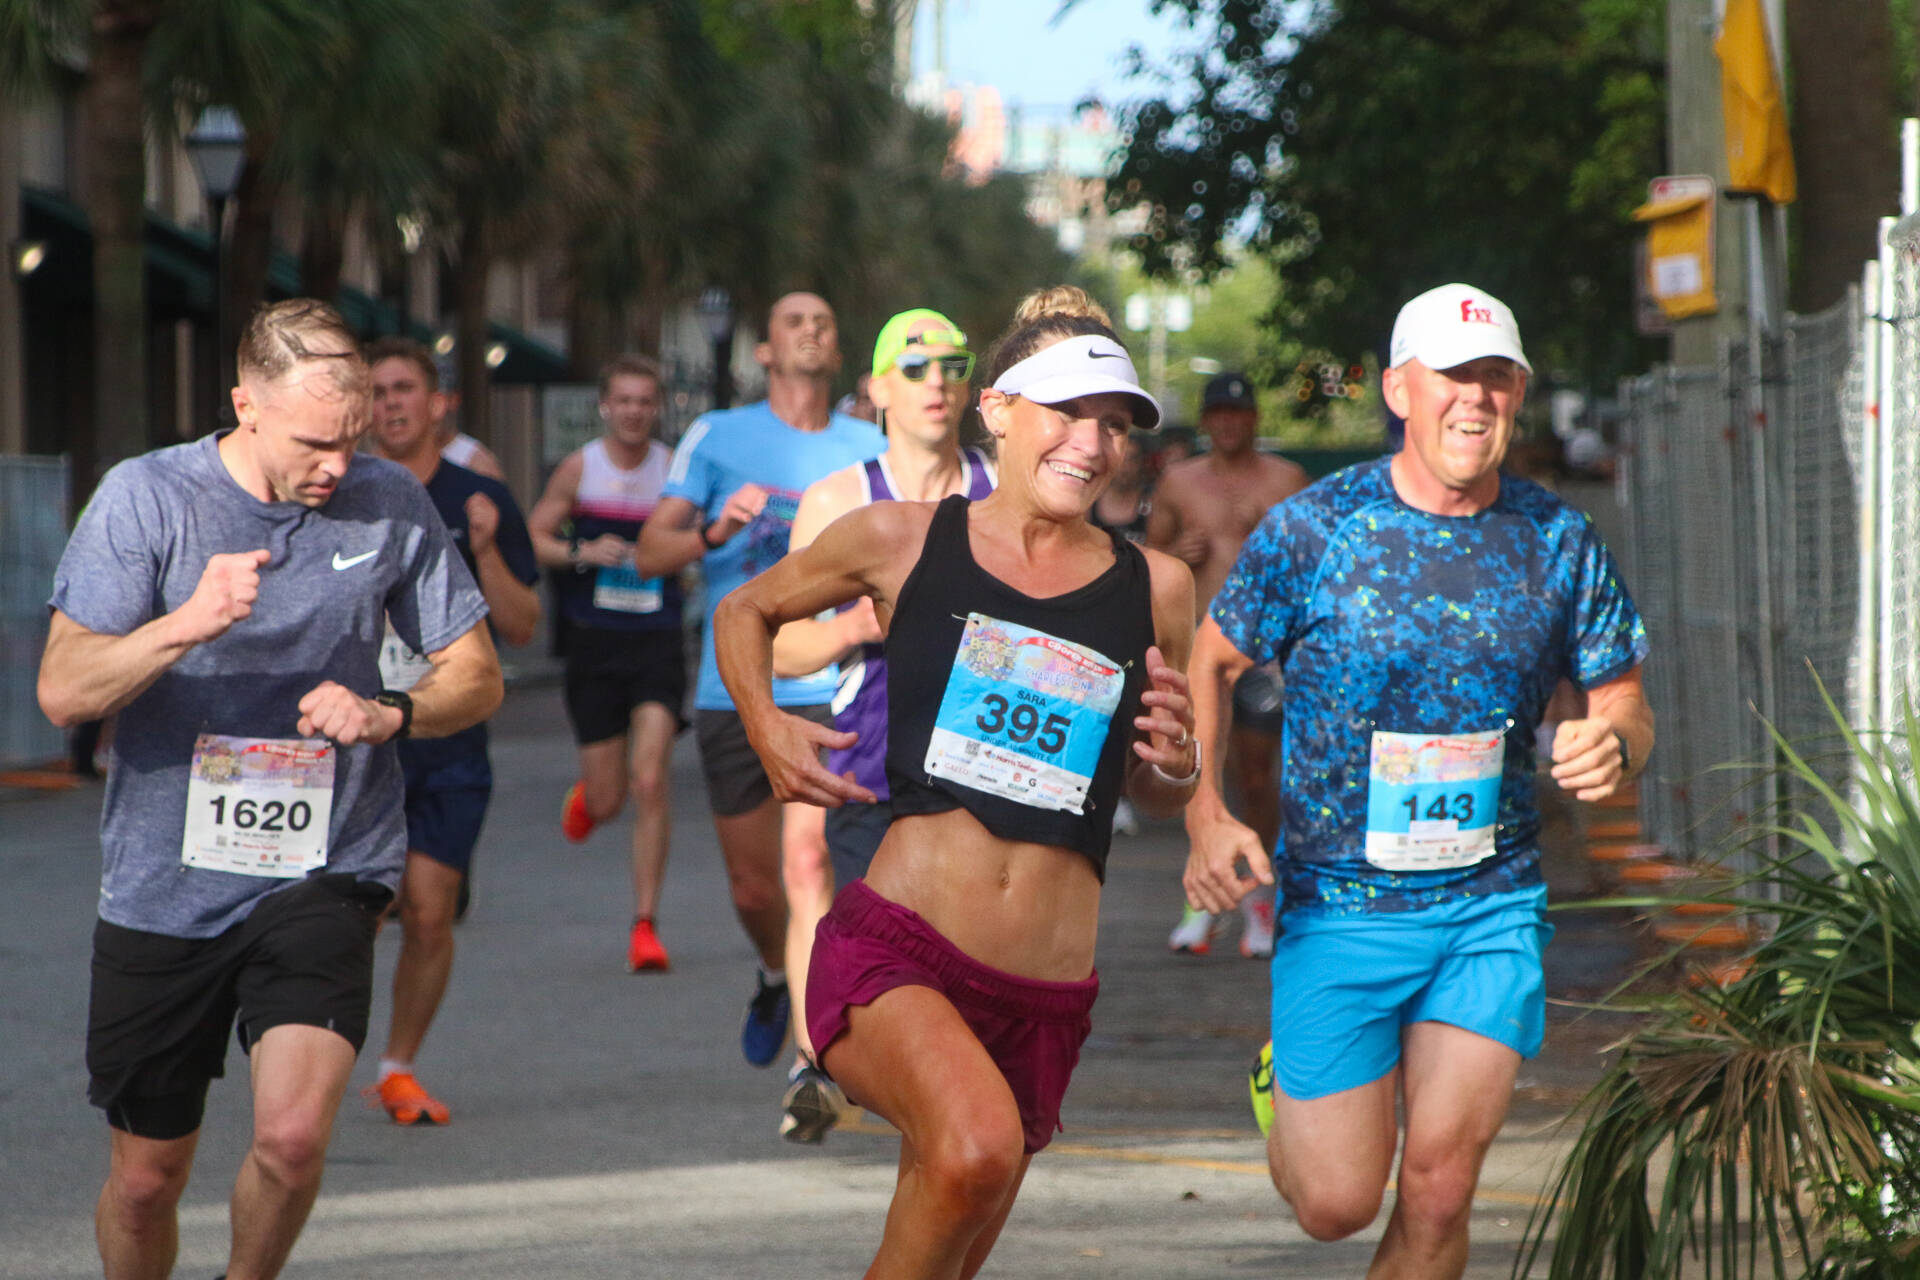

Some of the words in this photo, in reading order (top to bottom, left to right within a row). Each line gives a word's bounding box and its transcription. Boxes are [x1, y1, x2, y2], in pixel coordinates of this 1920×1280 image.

[1025, 668, 1088, 691] CHARLESTON
[1016, 690, 1046, 707] SARA
[976, 693, 1072, 755] 395
[981, 734, 1007, 748] UNDER
[1018, 745, 1051, 762] MINUTES
[209, 795, 312, 832] 1620
[1402, 793, 1475, 823] 143
